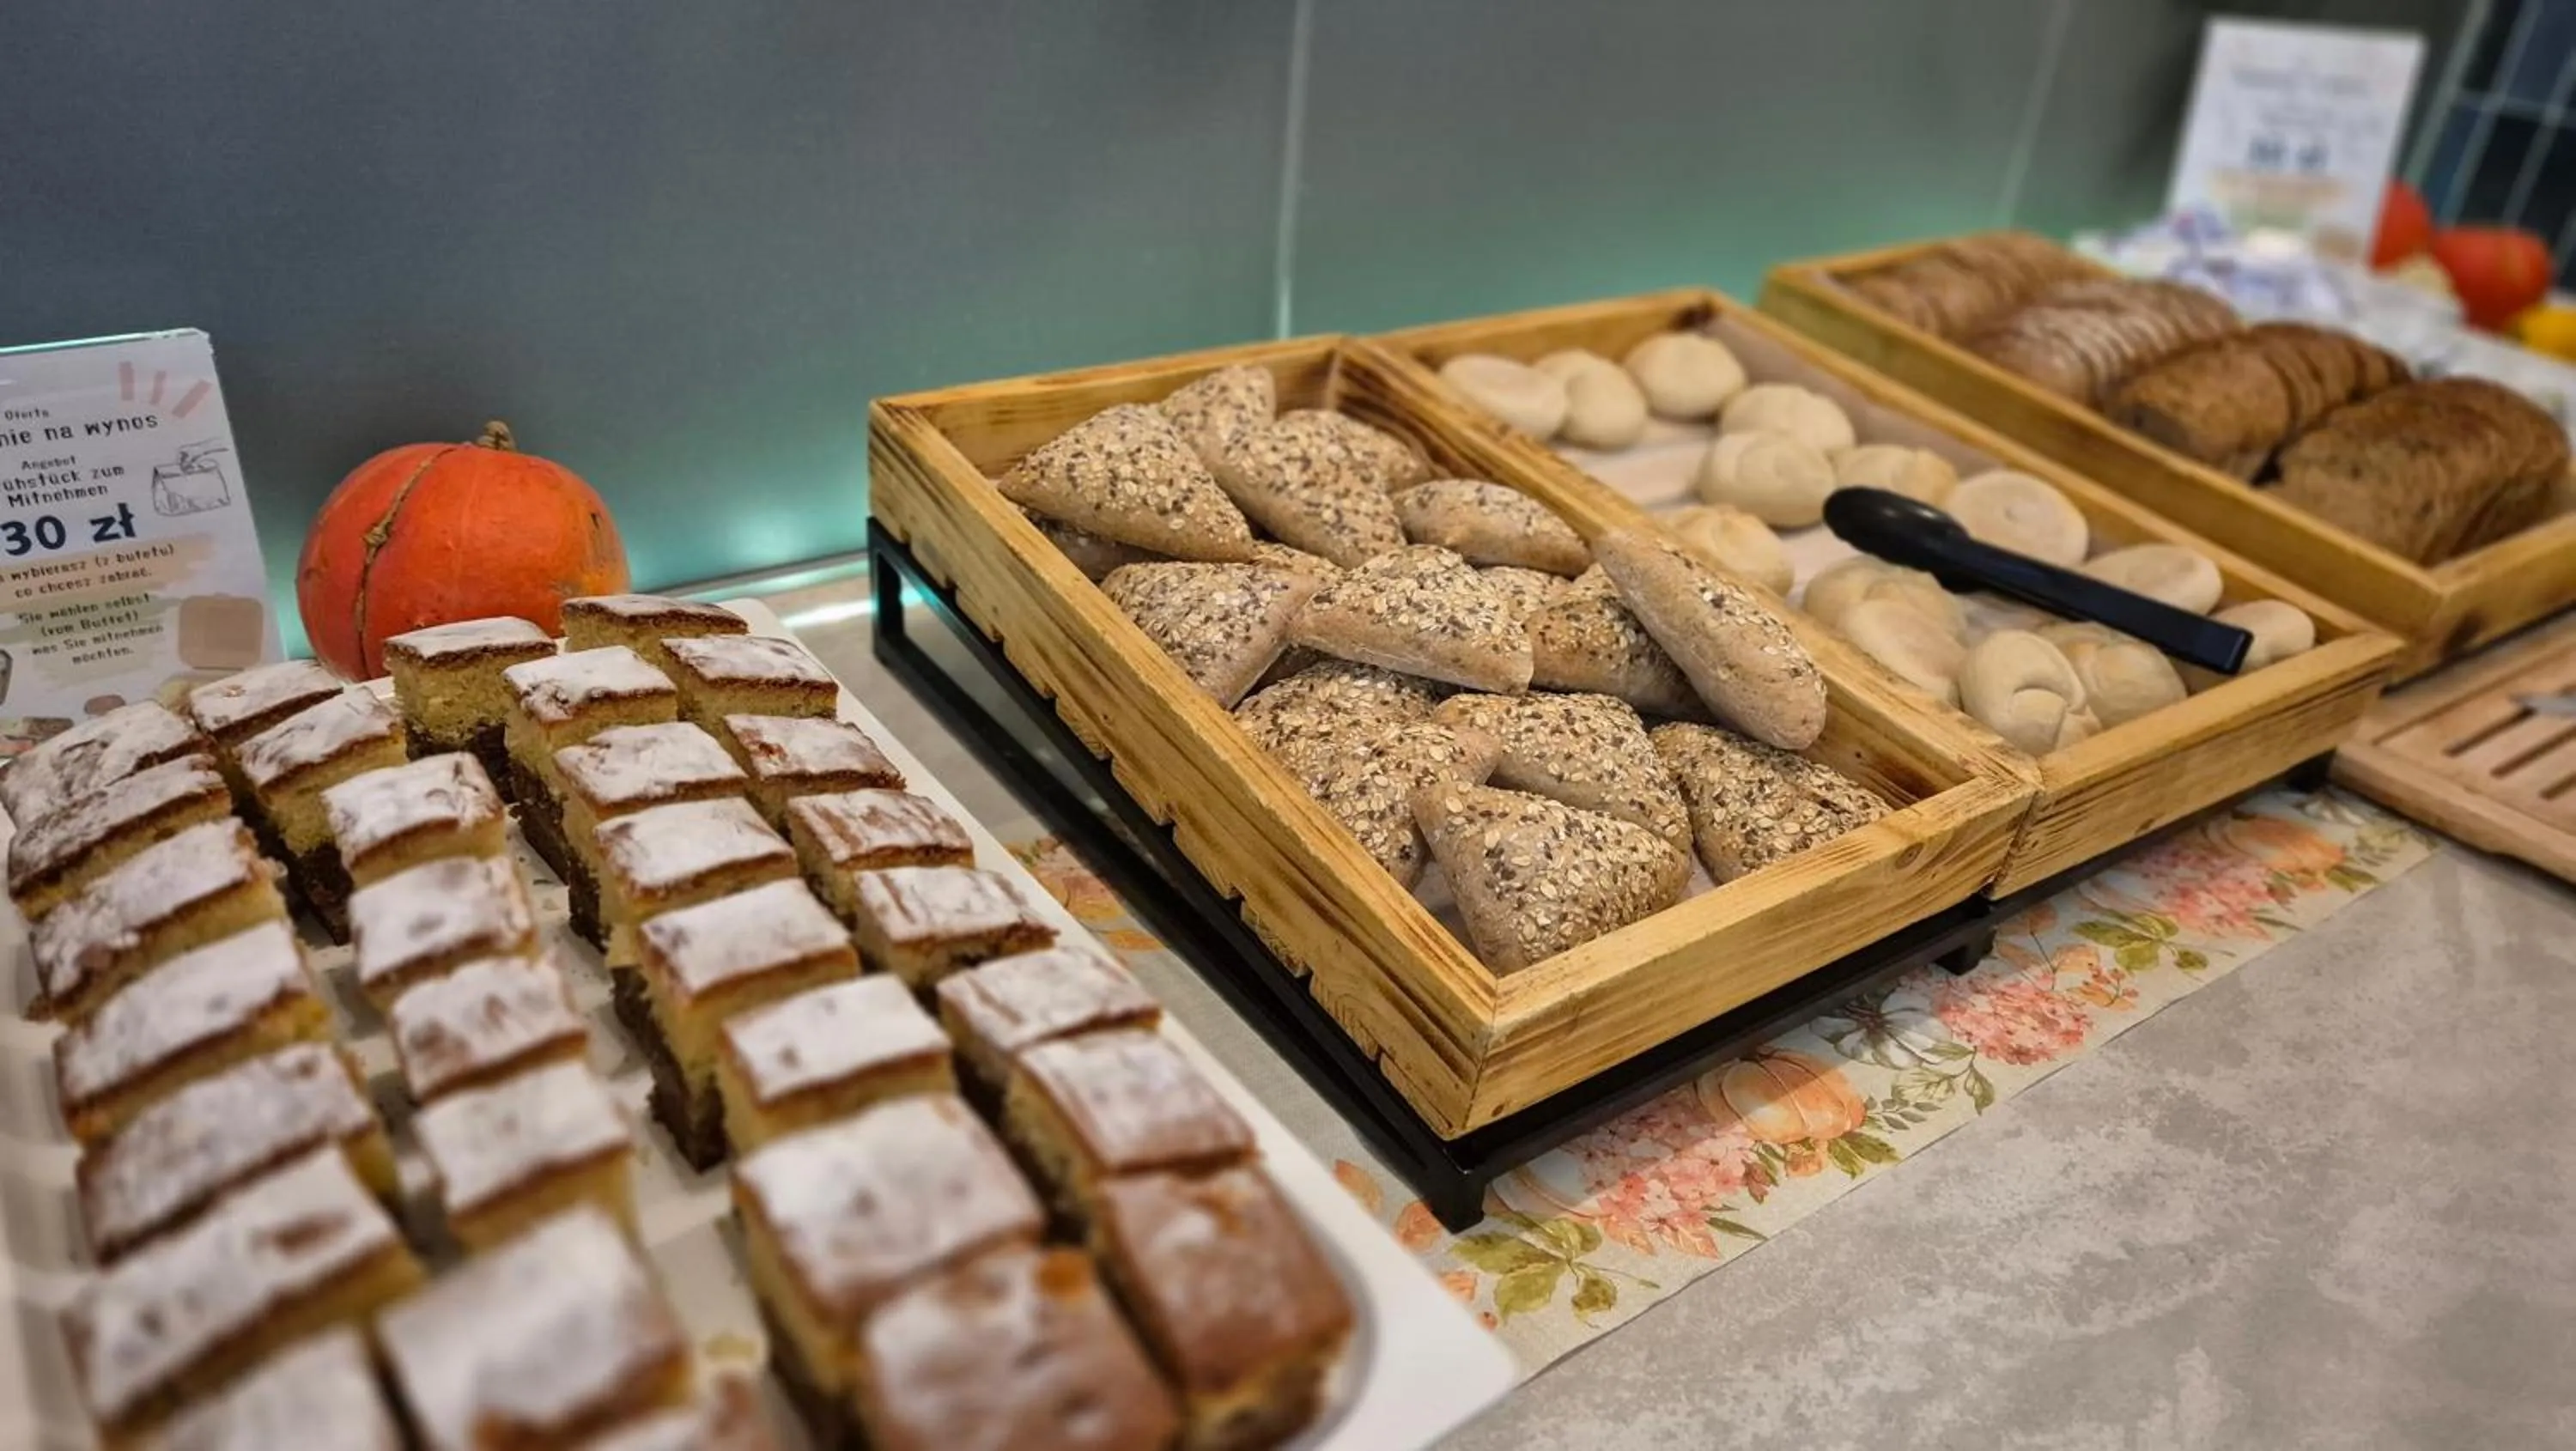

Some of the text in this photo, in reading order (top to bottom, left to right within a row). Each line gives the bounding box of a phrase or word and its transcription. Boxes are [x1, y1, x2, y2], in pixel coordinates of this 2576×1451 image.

[44, 425, 74, 441] na
[84, 415, 159, 436] wynos
[21, 454, 76, 471] Angebot
[90, 465, 125, 479] zum
[8, 483, 109, 507] Mitnehmen
[0, 502, 136, 556] 30 zł
[15, 587, 33, 598] co
